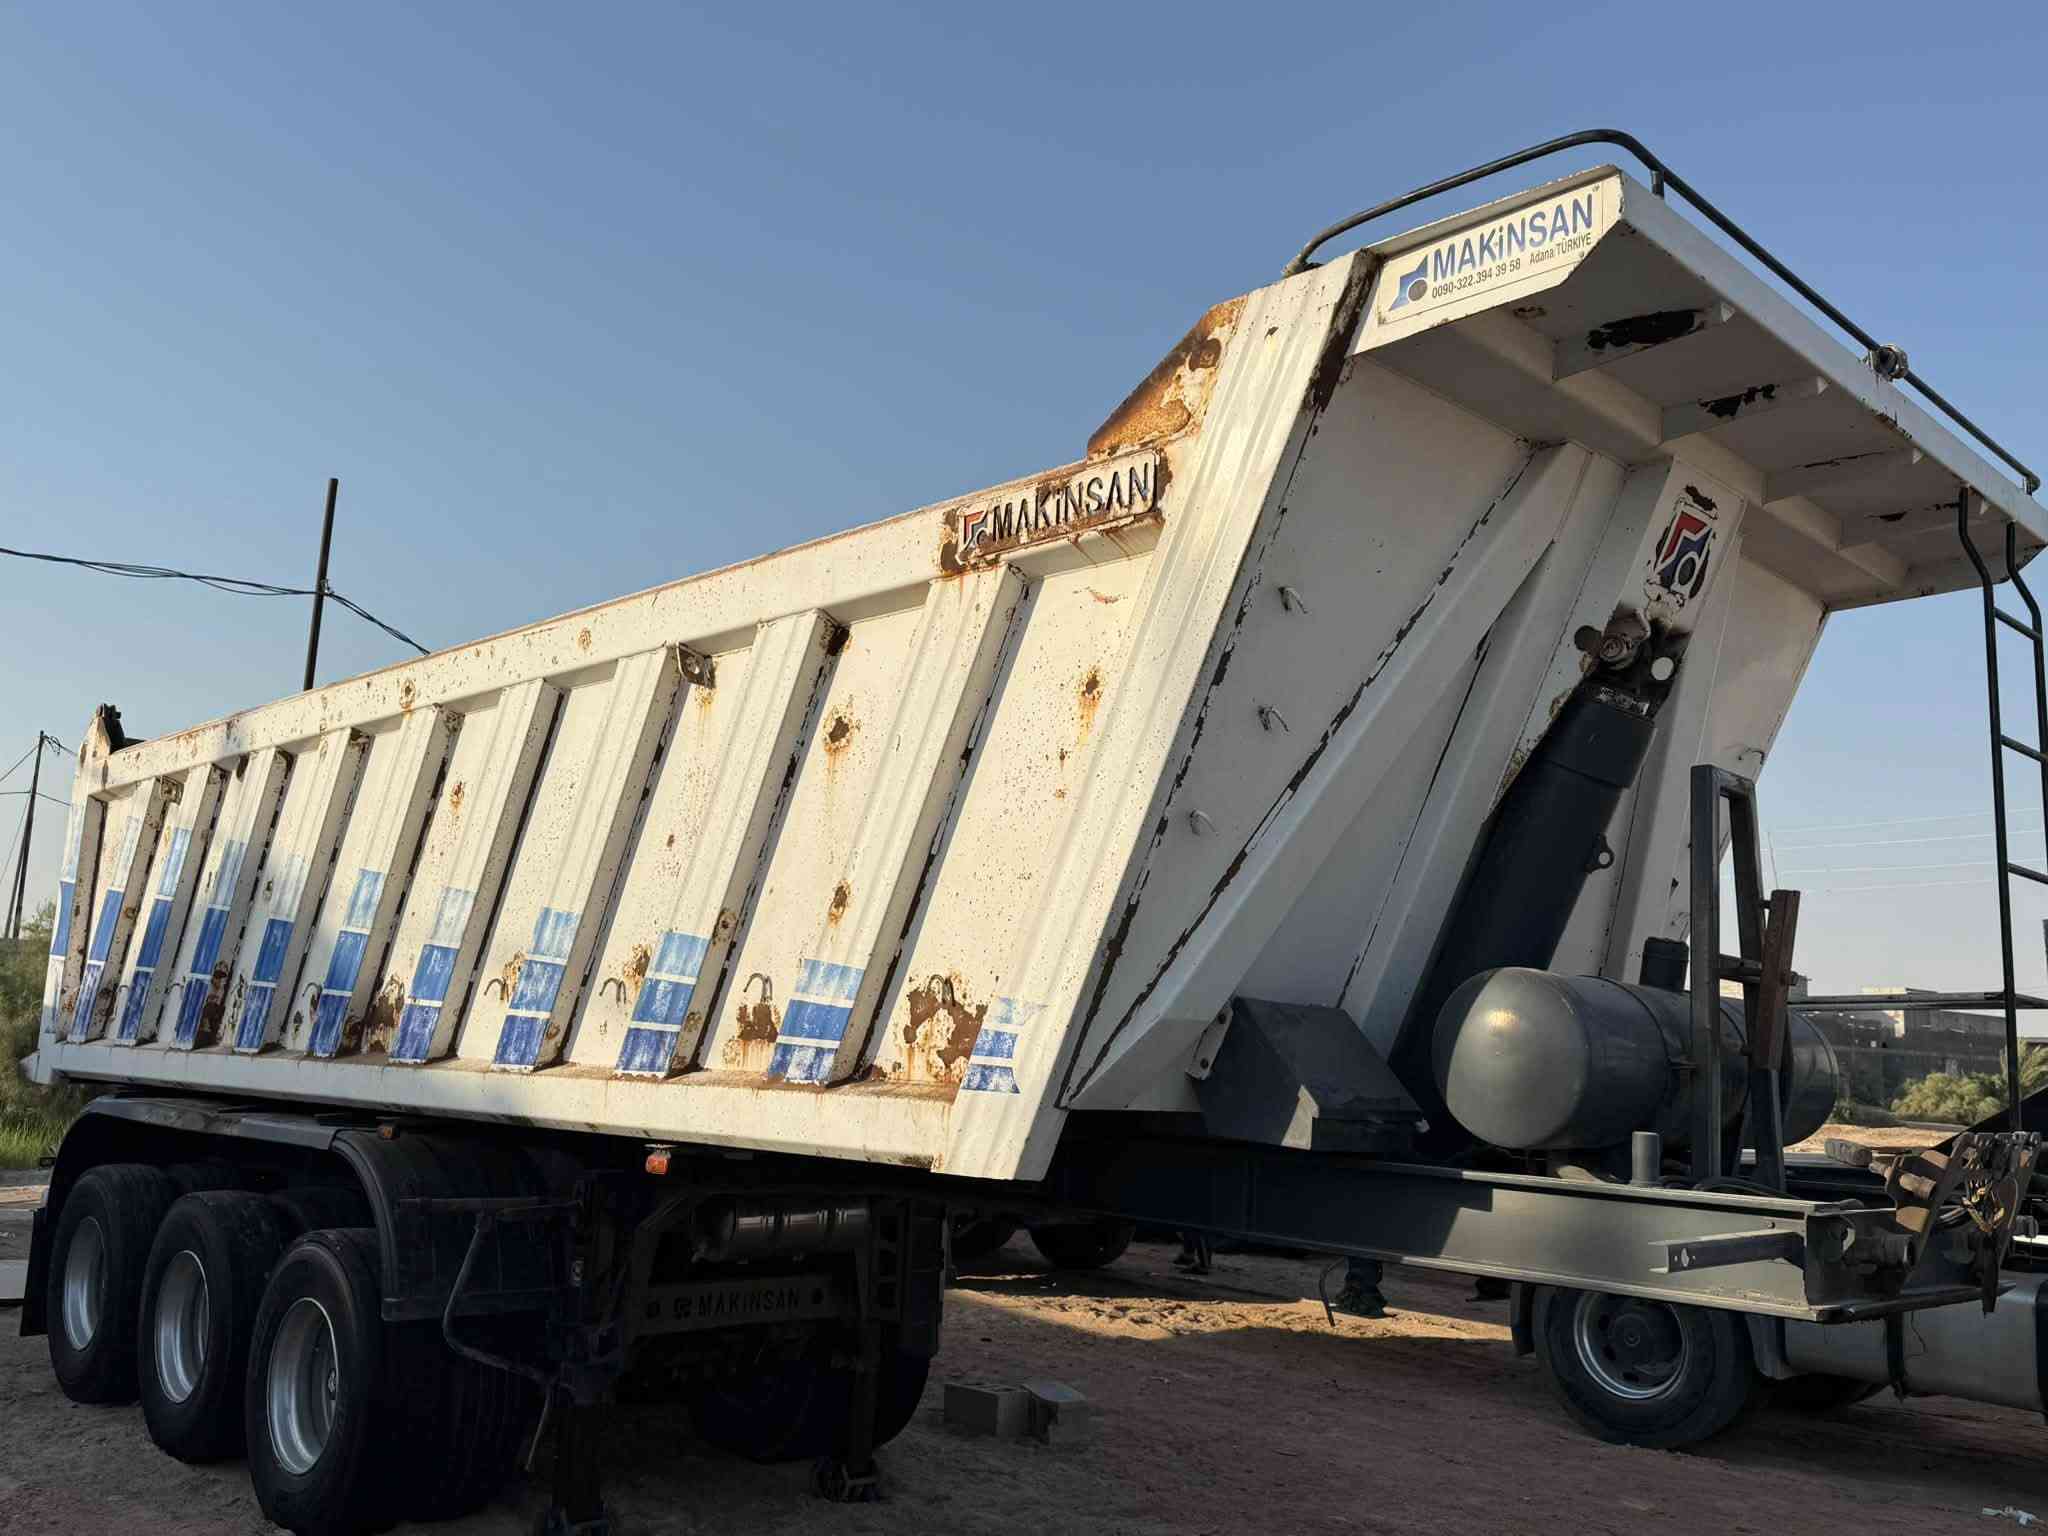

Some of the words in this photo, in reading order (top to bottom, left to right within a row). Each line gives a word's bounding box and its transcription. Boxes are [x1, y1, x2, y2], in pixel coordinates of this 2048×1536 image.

[1529, 249, 1554, 266] Adana
[1431, 267, 1493, 299] 0090-322.394
[1495, 262, 1507, 278] 39
[1509, 257, 1521, 273] 58
